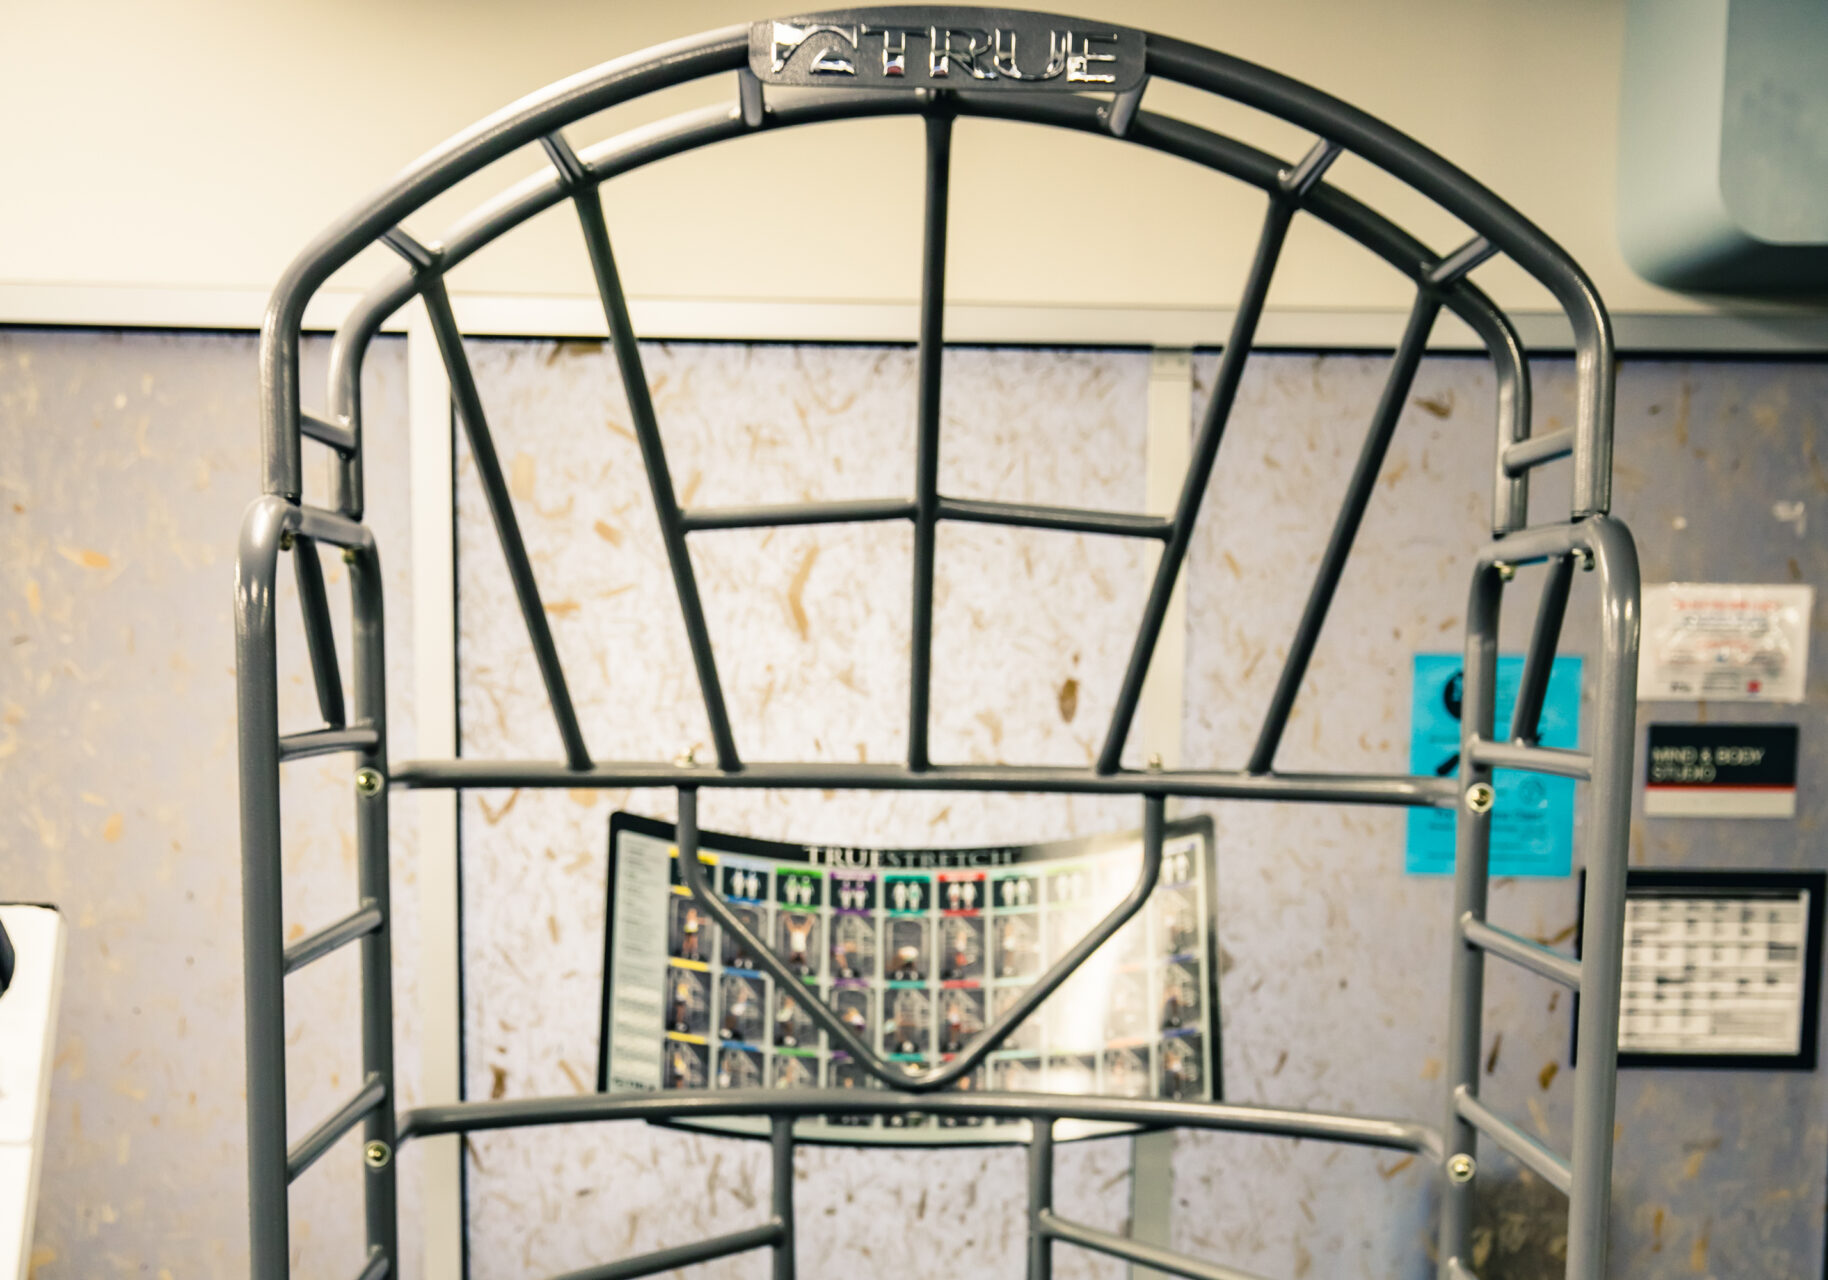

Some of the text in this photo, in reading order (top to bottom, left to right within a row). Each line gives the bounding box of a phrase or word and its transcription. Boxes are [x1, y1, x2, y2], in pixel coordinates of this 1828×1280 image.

[861, 23, 1118, 83] TRUE
[1652, 746, 1698, 764] MIND
[1716, 746, 1765, 766] BODY
[1652, 762, 1717, 783] STUDIO
